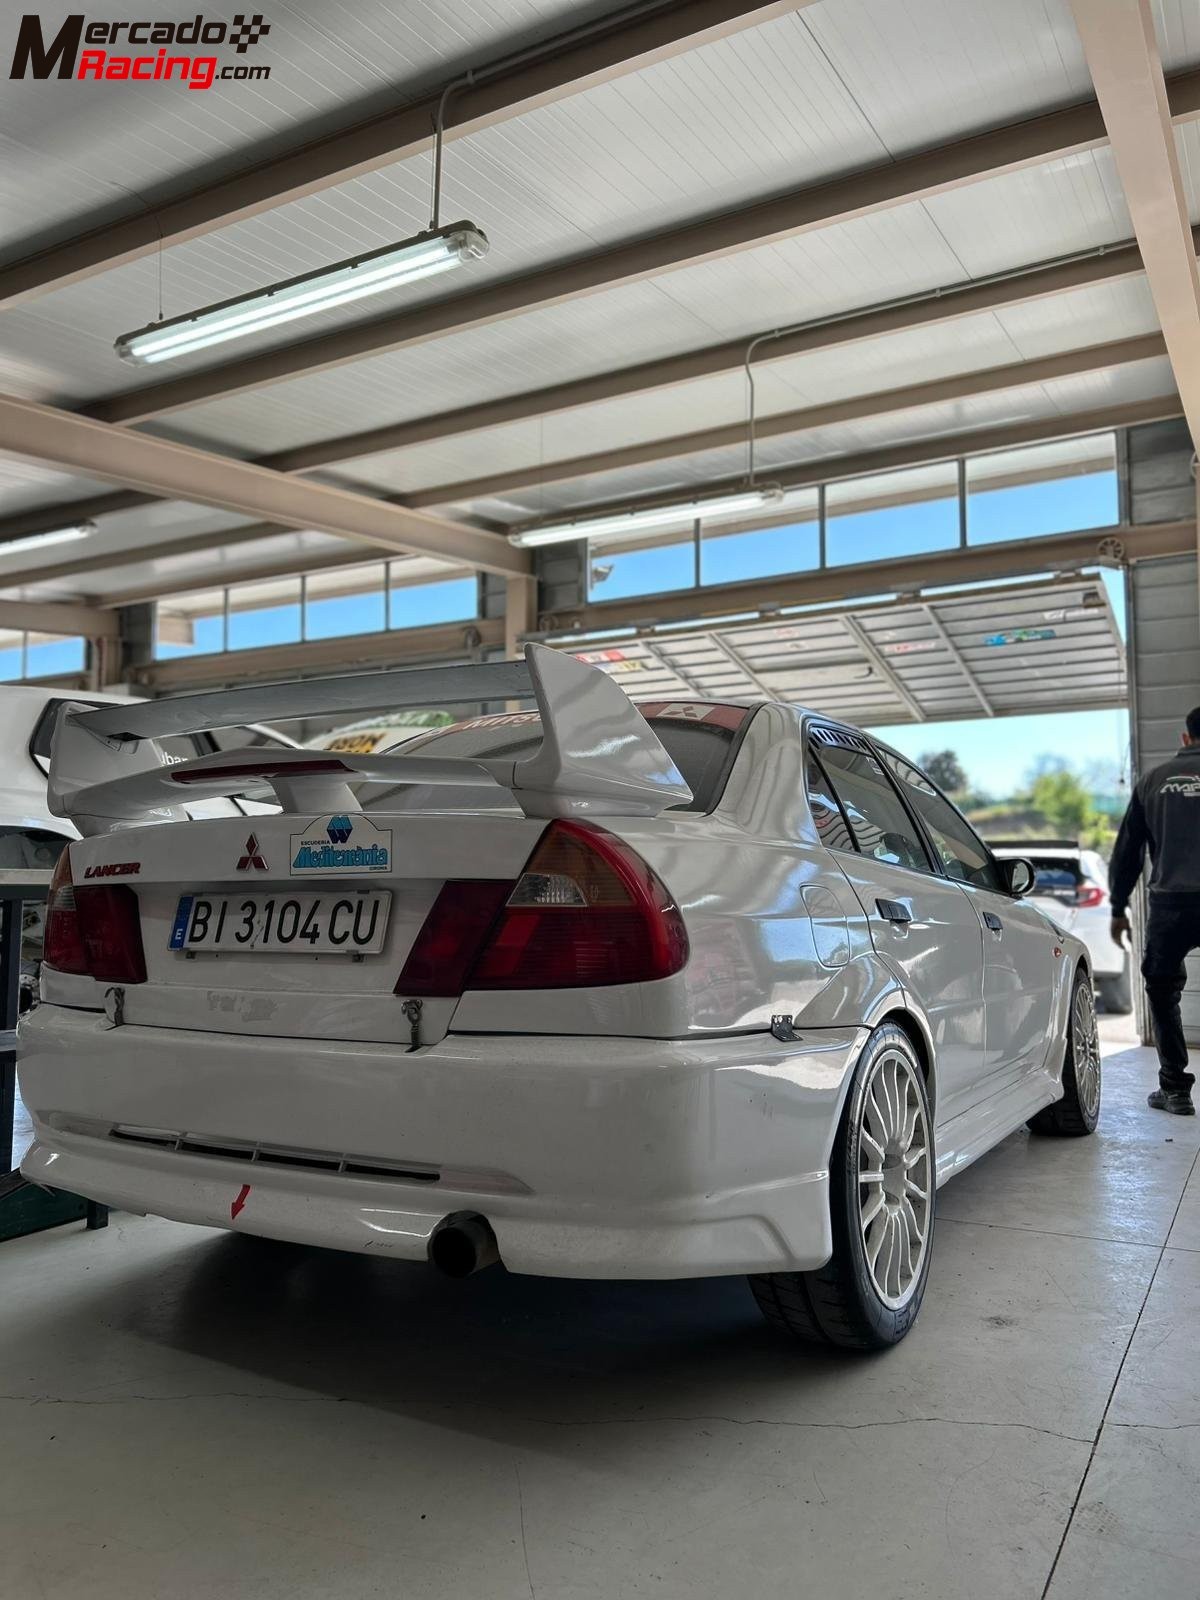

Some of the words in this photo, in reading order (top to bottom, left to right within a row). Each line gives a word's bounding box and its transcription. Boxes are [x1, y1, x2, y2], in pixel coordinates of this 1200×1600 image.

[84, 862, 141, 879] LANCER
[188, 901, 228, 943] BI
[235, 900, 320, 944] 3104
[328, 899, 380, 945] CU
[175, 928, 184, 940] E
